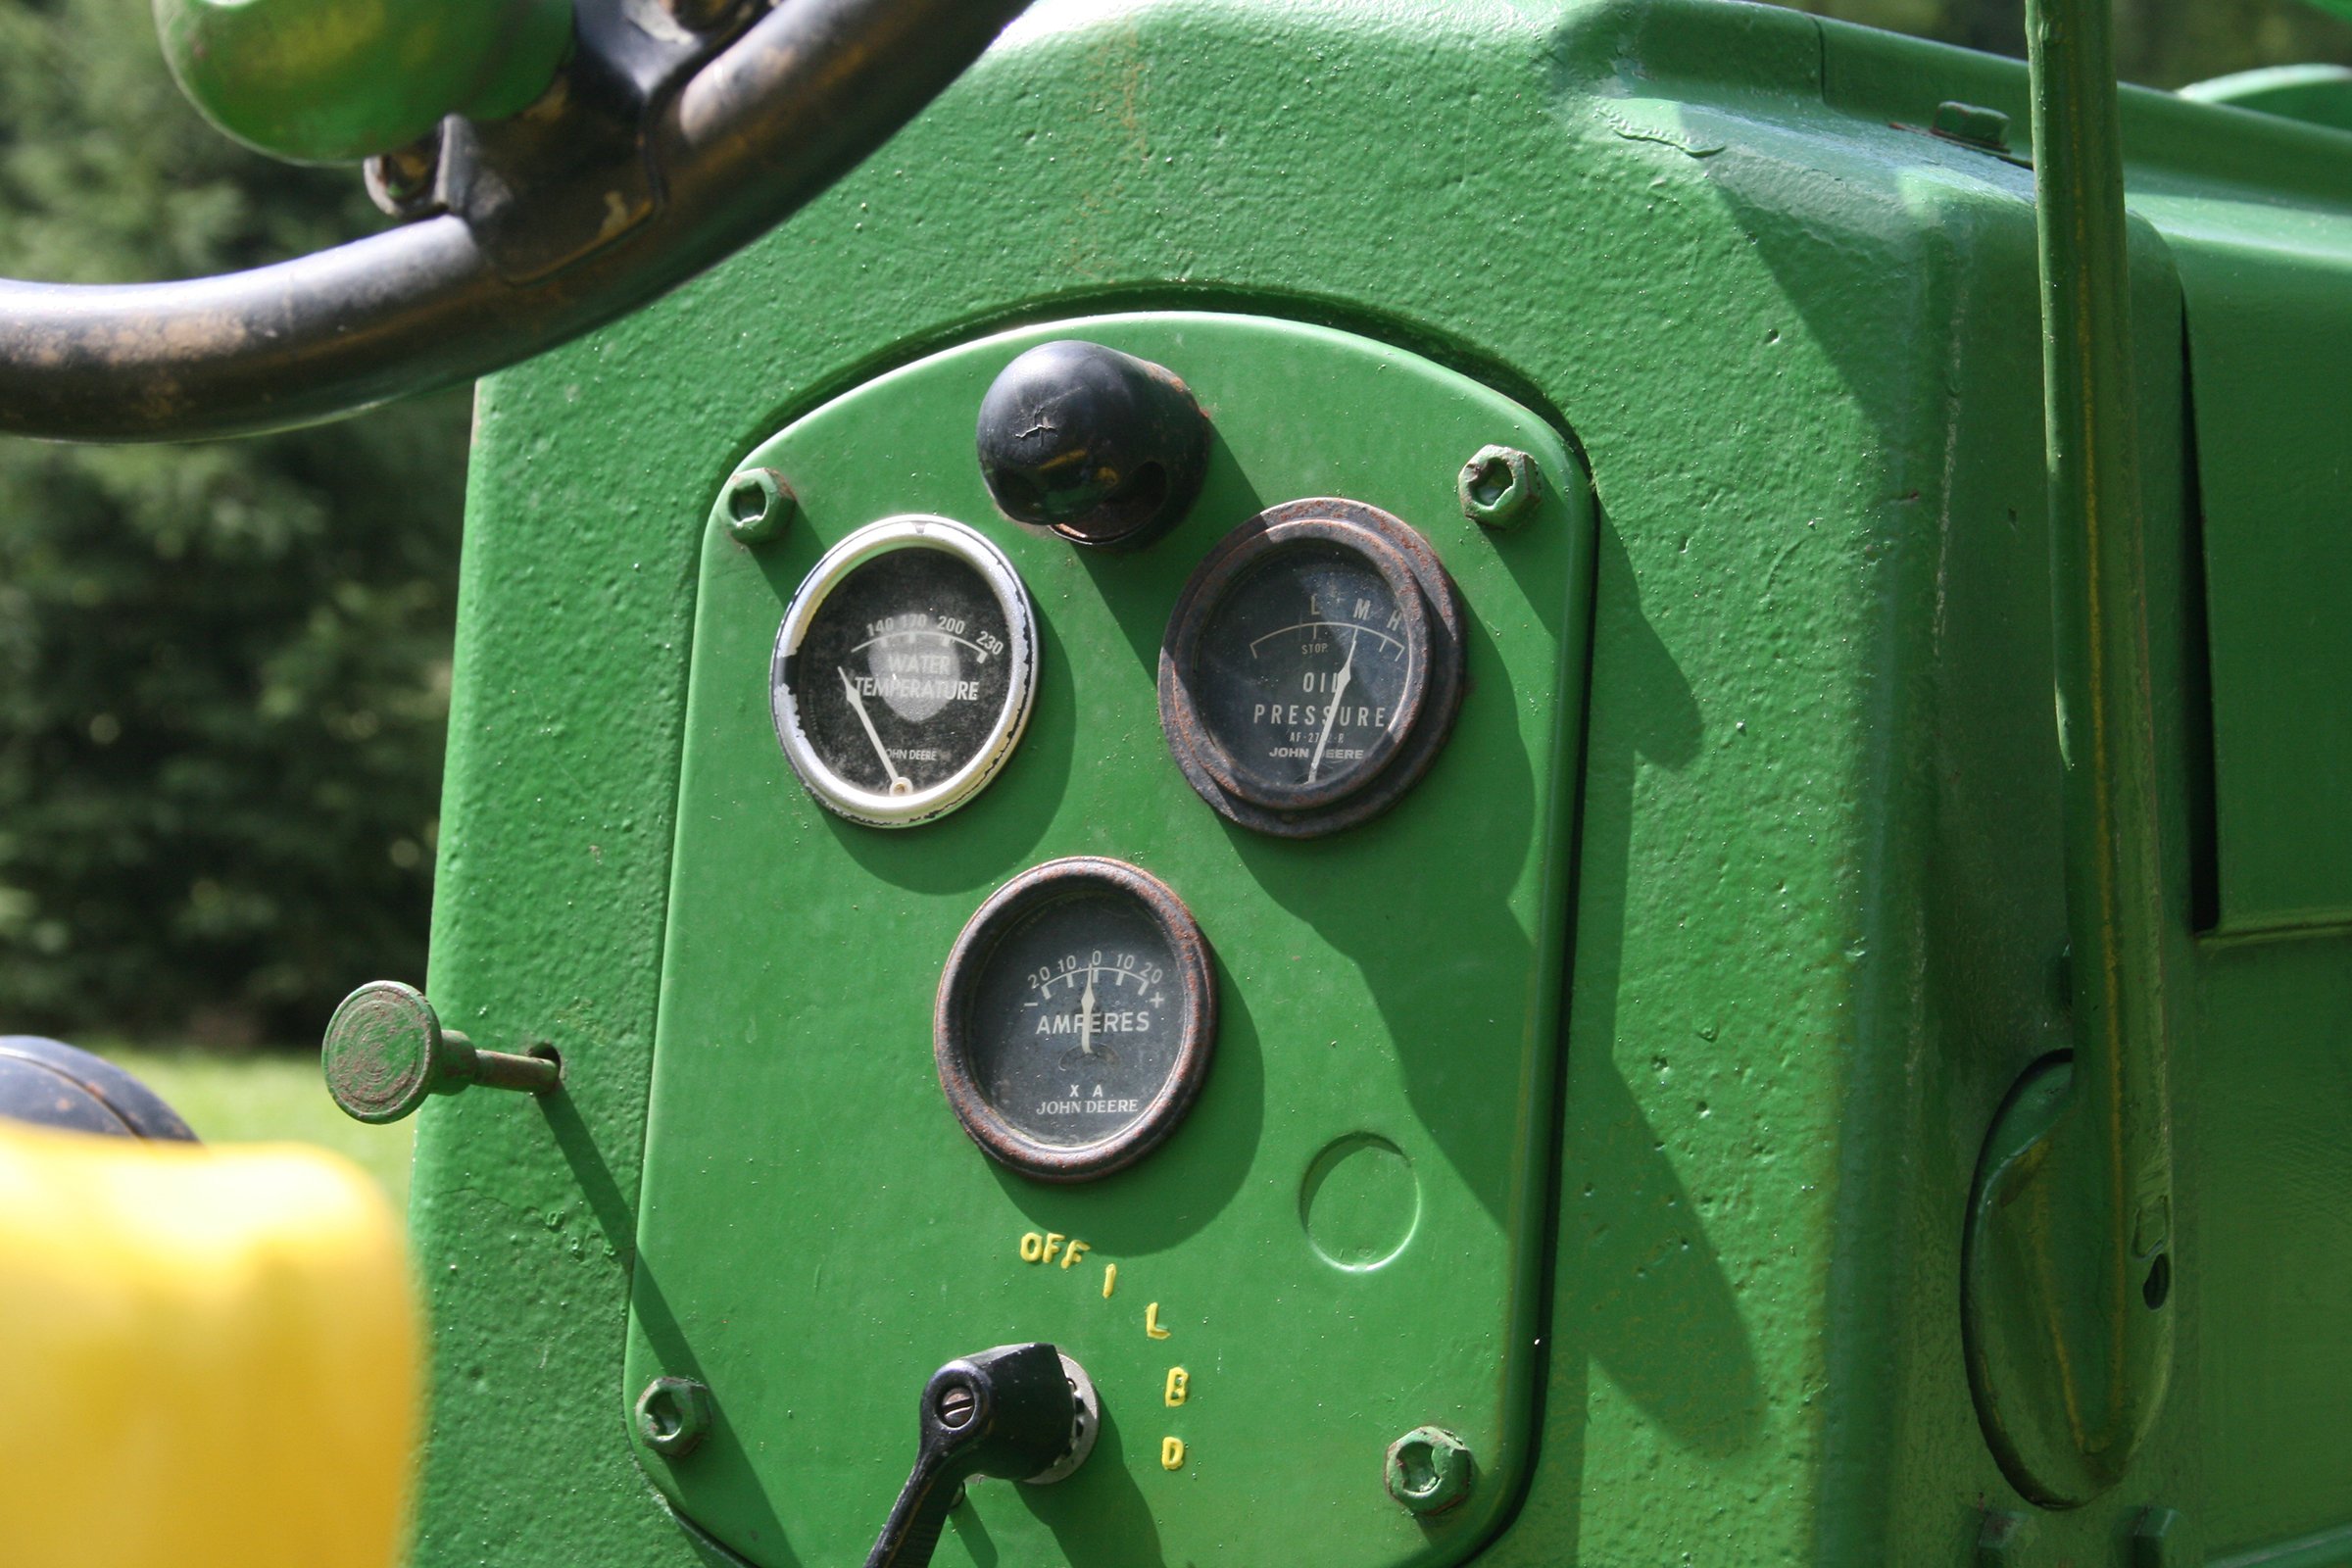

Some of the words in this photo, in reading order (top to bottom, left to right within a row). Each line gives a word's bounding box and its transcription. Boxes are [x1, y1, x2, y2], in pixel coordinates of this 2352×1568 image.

[1311, 595, 1320, 615] L
[1353, 598, 1371, 620] M
[1387, 610, 1402, 631] H
[867, 617, 894, 636] 140
[904, 613, 927, 627] 170
[937, 615, 965, 635] 200
[976, 630, 1004, 655] 230
[1301, 643, 1328, 655] STOP
[887, 654, 951, 675] WATER
[855, 677, 979, 701] TEMPERATURE
[1302, 672, 1339, 693] OIL
[1254, 704, 1386, 727] PRESSURE
[885, 748, 906, 760] OHN
[909, 749, 938, 761] DEERE
[1269, 747, 1309, 759] JOHN
[1322, 749, 1364, 760] EERE
[1028, 966, 1051, 990] 20
[1058, 955, 1076, 973] 10
[1092, 950, 1102, 966] 0
[1116, 954, 1135, 970] 10
[1139, 961, 1163, 984] 20
[1036, 1011, 1150, 1035] AMPERES
[1069, 1084, 1080, 1098] X
[1092, 1084, 1103, 1098] A
[1036, 1100, 1081, 1115] JOHN
[1085, 1099, 1139, 1113] DEERE
[1020, 1232, 1091, 1269] OFF
[1145, 1301, 1171, 1340] L
[1165, 1366, 1189, 1407] B
[1161, 1436, 1184, 1470] D
